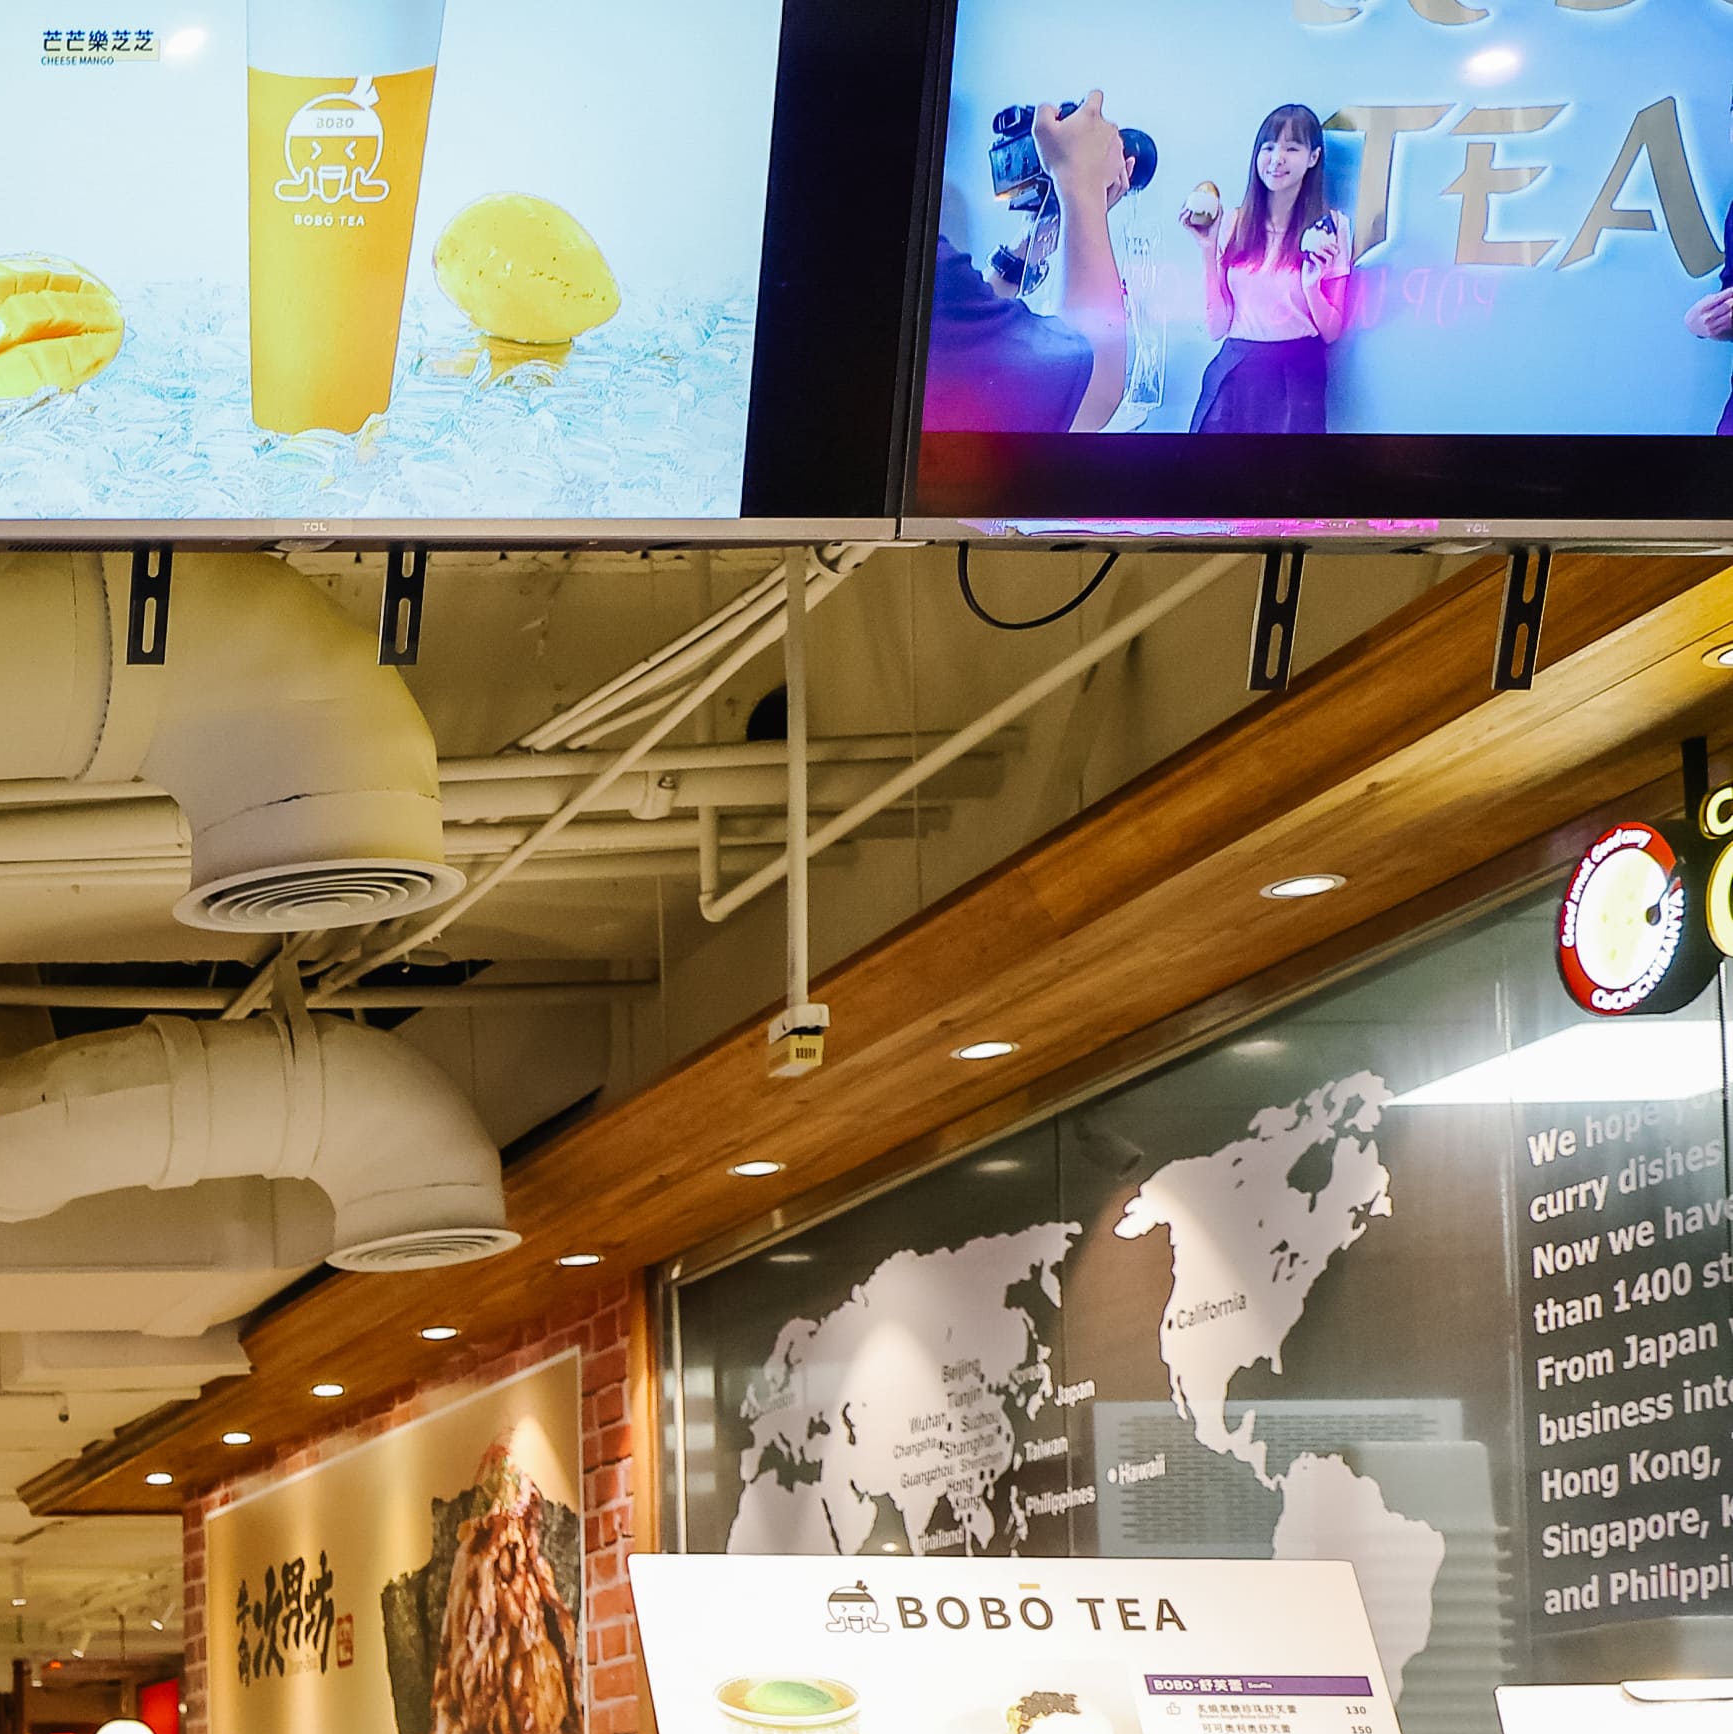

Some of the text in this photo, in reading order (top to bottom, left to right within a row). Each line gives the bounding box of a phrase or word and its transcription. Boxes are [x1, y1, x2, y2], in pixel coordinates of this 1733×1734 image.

[43, 30, 154, 52] 芒芒樂芝芝
[41, 56, 114, 65] CHEESE MANGO
[316, 117, 355, 129] BOBO
[1319, 95, 1726, 279] TEA
[338, 215, 366, 227] TEA
[1528, 1125, 1576, 1168] We
[1584, 1105, 1659, 1150] hope
[1529, 1137, 1723, 1224] curry dishes
[1532, 1235, 1600, 1279] Now
[1607, 1219, 1655, 1257] we
[1177, 1292, 1248, 1333] California
[1533, 1261, 1692, 1336] than 1400
[942, 1358, 981, 1383] Beijing
[1536, 1347, 1614, 1391] From
[1623, 1320, 1718, 1372] Japan
[947, 1387, 982, 1407] Tianjin
[1054, 1380, 1096, 1407] Japan
[910, 1413, 948, 1434] Wuhan
[960, 1411, 999, 1433] Suzhou
[1540, 1391, 1674, 1447] business
[944, 1433, 996, 1460] Shanghai
[1023, 1436, 1069, 1462] Taiwan
[900, 1464, 954, 1489] Guangzhou
[1118, 1453, 1166, 1485] Hawaii
[1541, 1443, 1722, 1504] Hong Kong,
[1025, 1485, 1096, 1518] Philippines
[1542, 1505, 1710, 1560] Singapore,
[1543, 1574, 1599, 1616] and
[1078, 1595, 1188, 1632] TEA
[1345, 1705, 1368, 1715] 130
